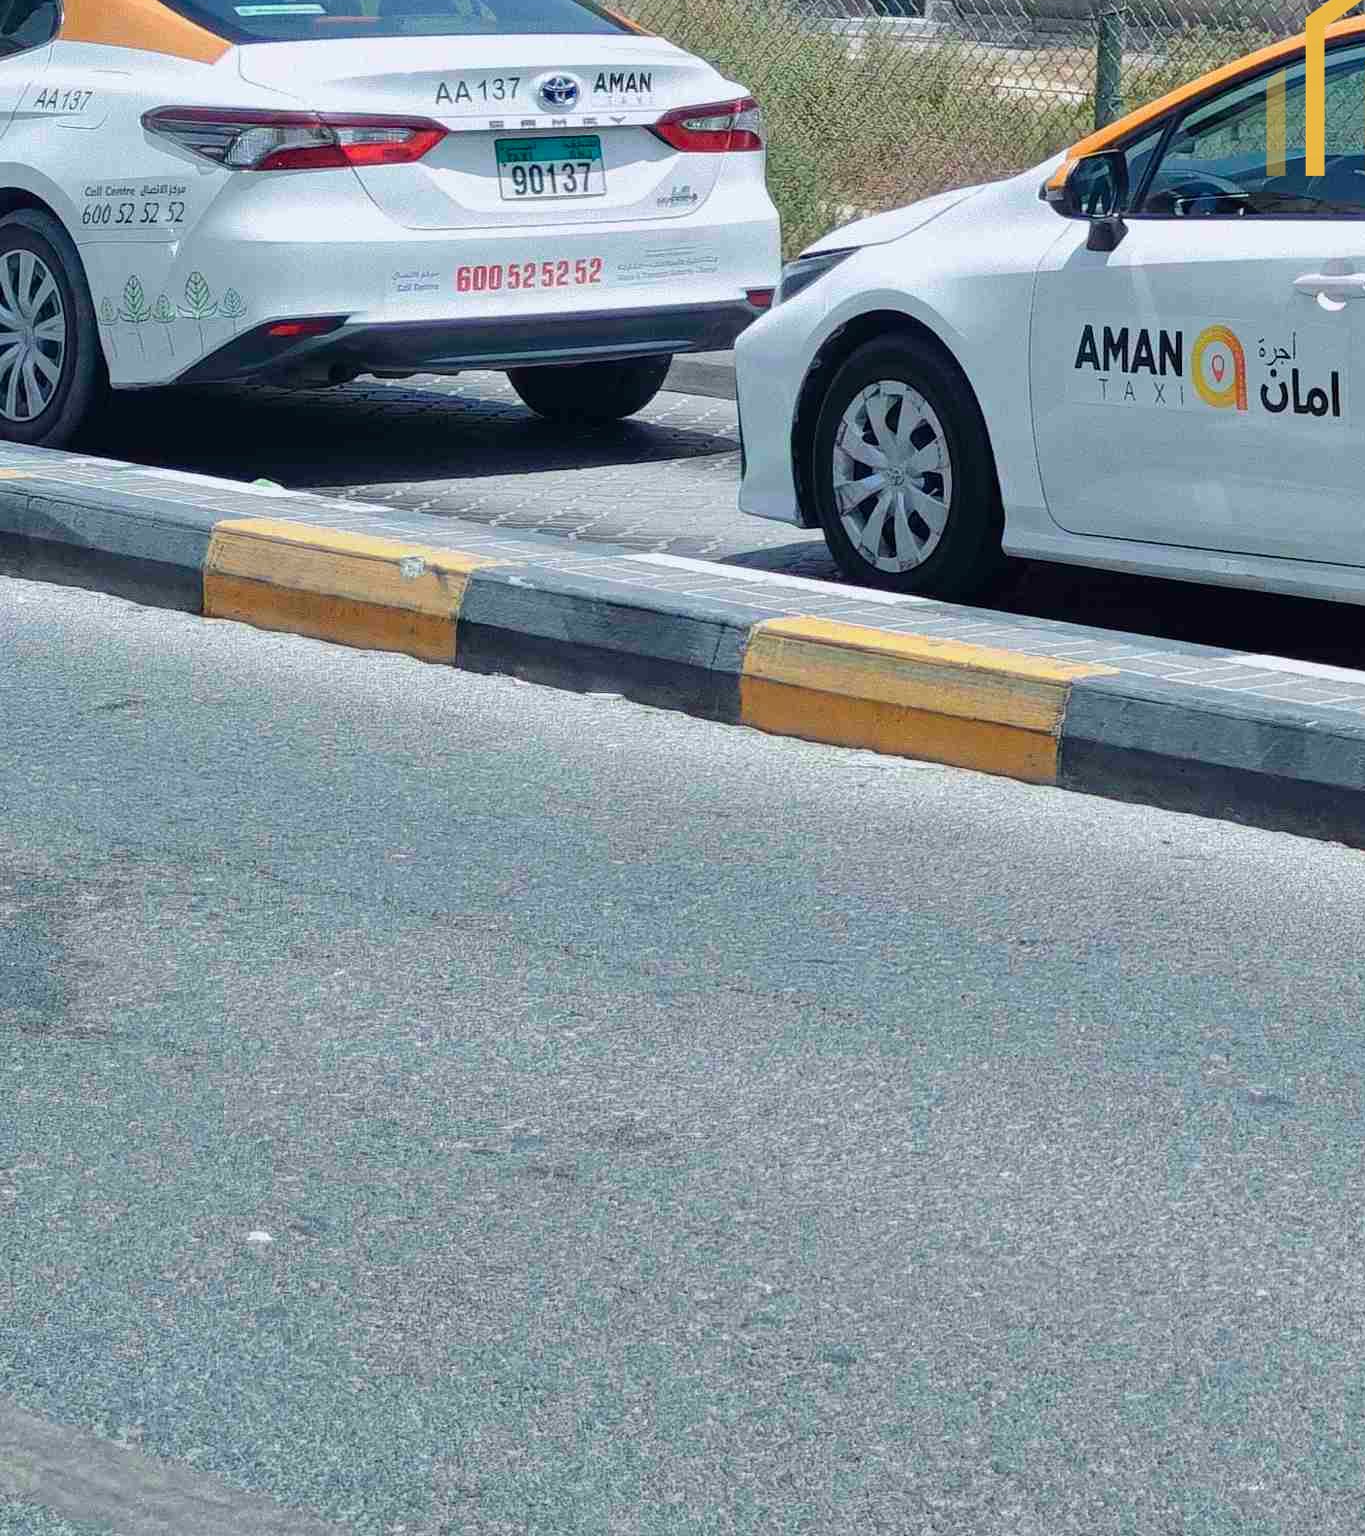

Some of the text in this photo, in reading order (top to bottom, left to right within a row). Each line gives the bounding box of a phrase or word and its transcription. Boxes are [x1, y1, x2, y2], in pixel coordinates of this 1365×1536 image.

[593, 71, 653, 94] AMAN
[84, 185, 136, 197] Call Centre
[511, 162, 592, 196] 90137
[82, 201, 186, 225] 600 52 52 52
[456, 264, 503, 293] 600
[506, 262, 536, 290] 52
[541, 259, 569, 288] 52
[574, 257, 603, 285] 52
[1074, 324, 1184, 378] AMAN
[1256, 330, 1297, 366] أجرة
[1098, 377, 1185, 408] TAXI
[1259, 367, 1341, 418] امان
